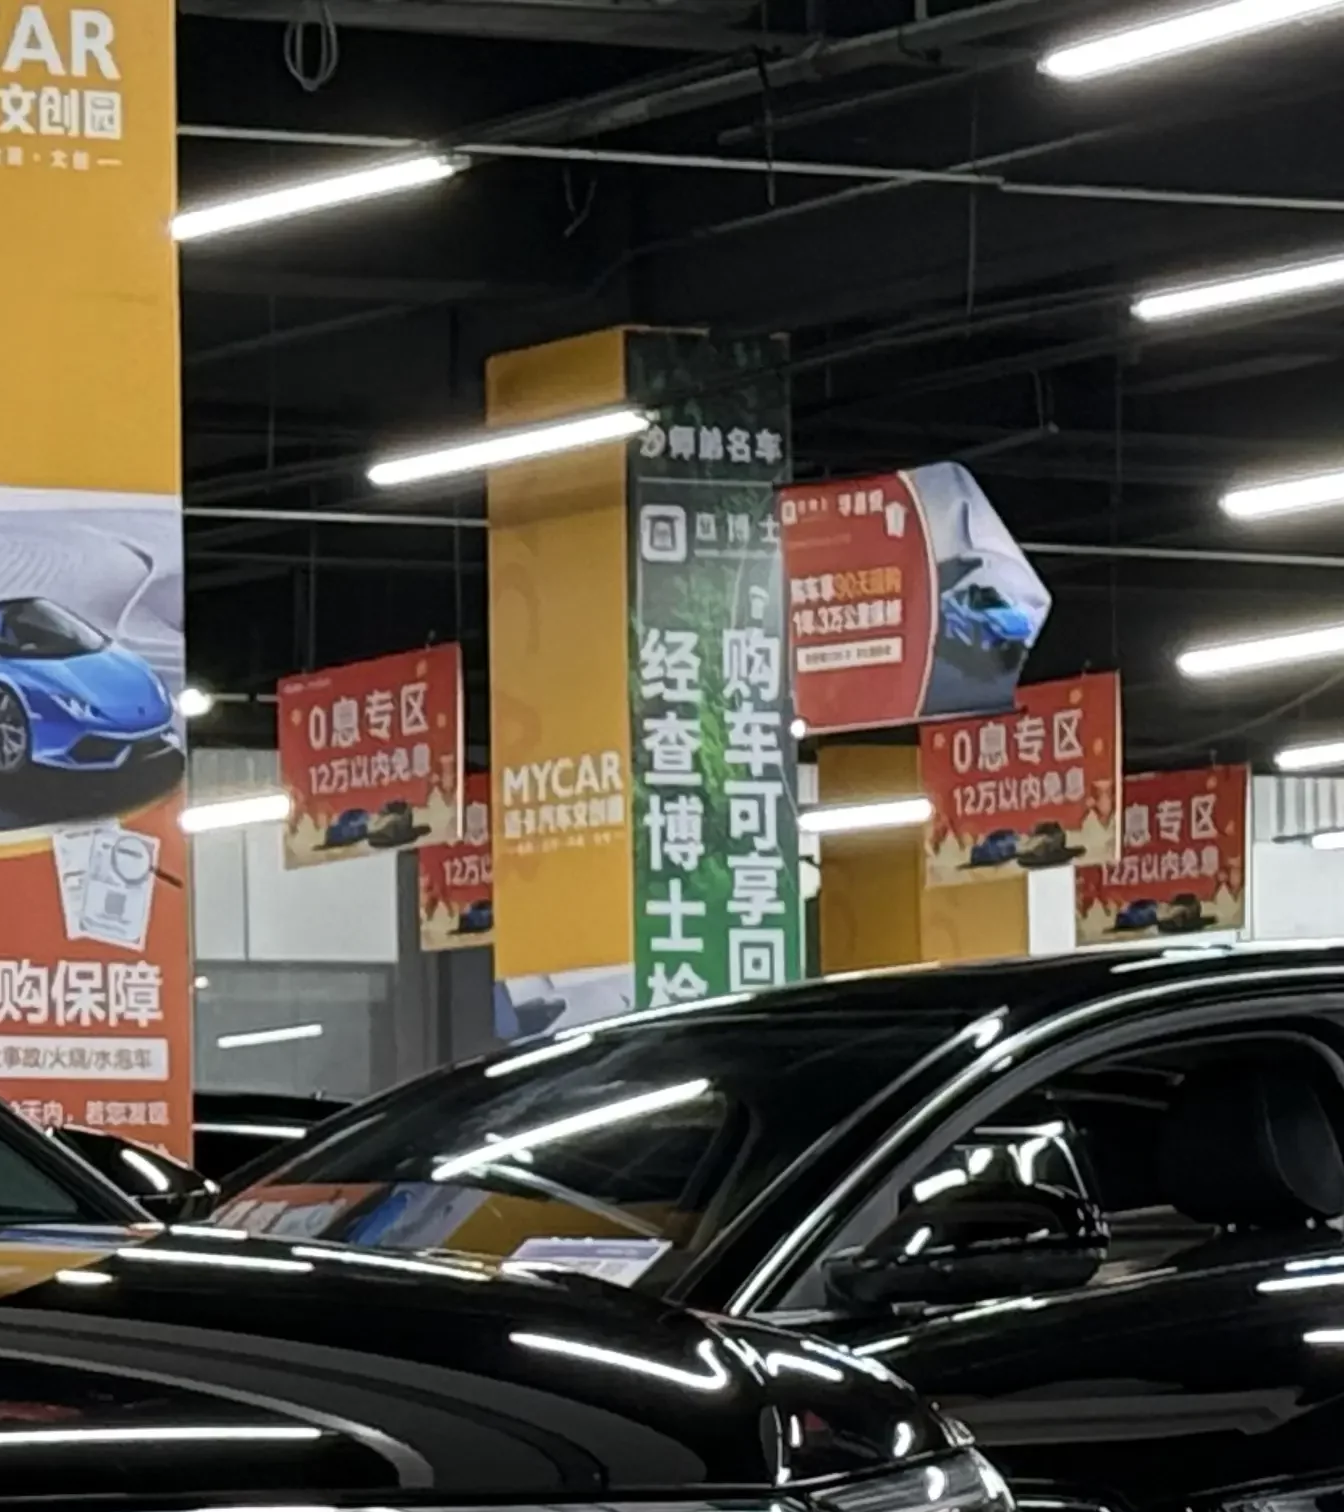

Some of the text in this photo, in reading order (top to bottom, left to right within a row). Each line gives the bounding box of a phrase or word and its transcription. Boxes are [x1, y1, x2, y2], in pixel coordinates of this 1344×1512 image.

[308, 682, 429, 750] 0息专区
[953, 709, 1083, 774] 0息专区
[502, 750, 624, 807] MYCAR
[722, 628, 787, 992] 购车可享回
